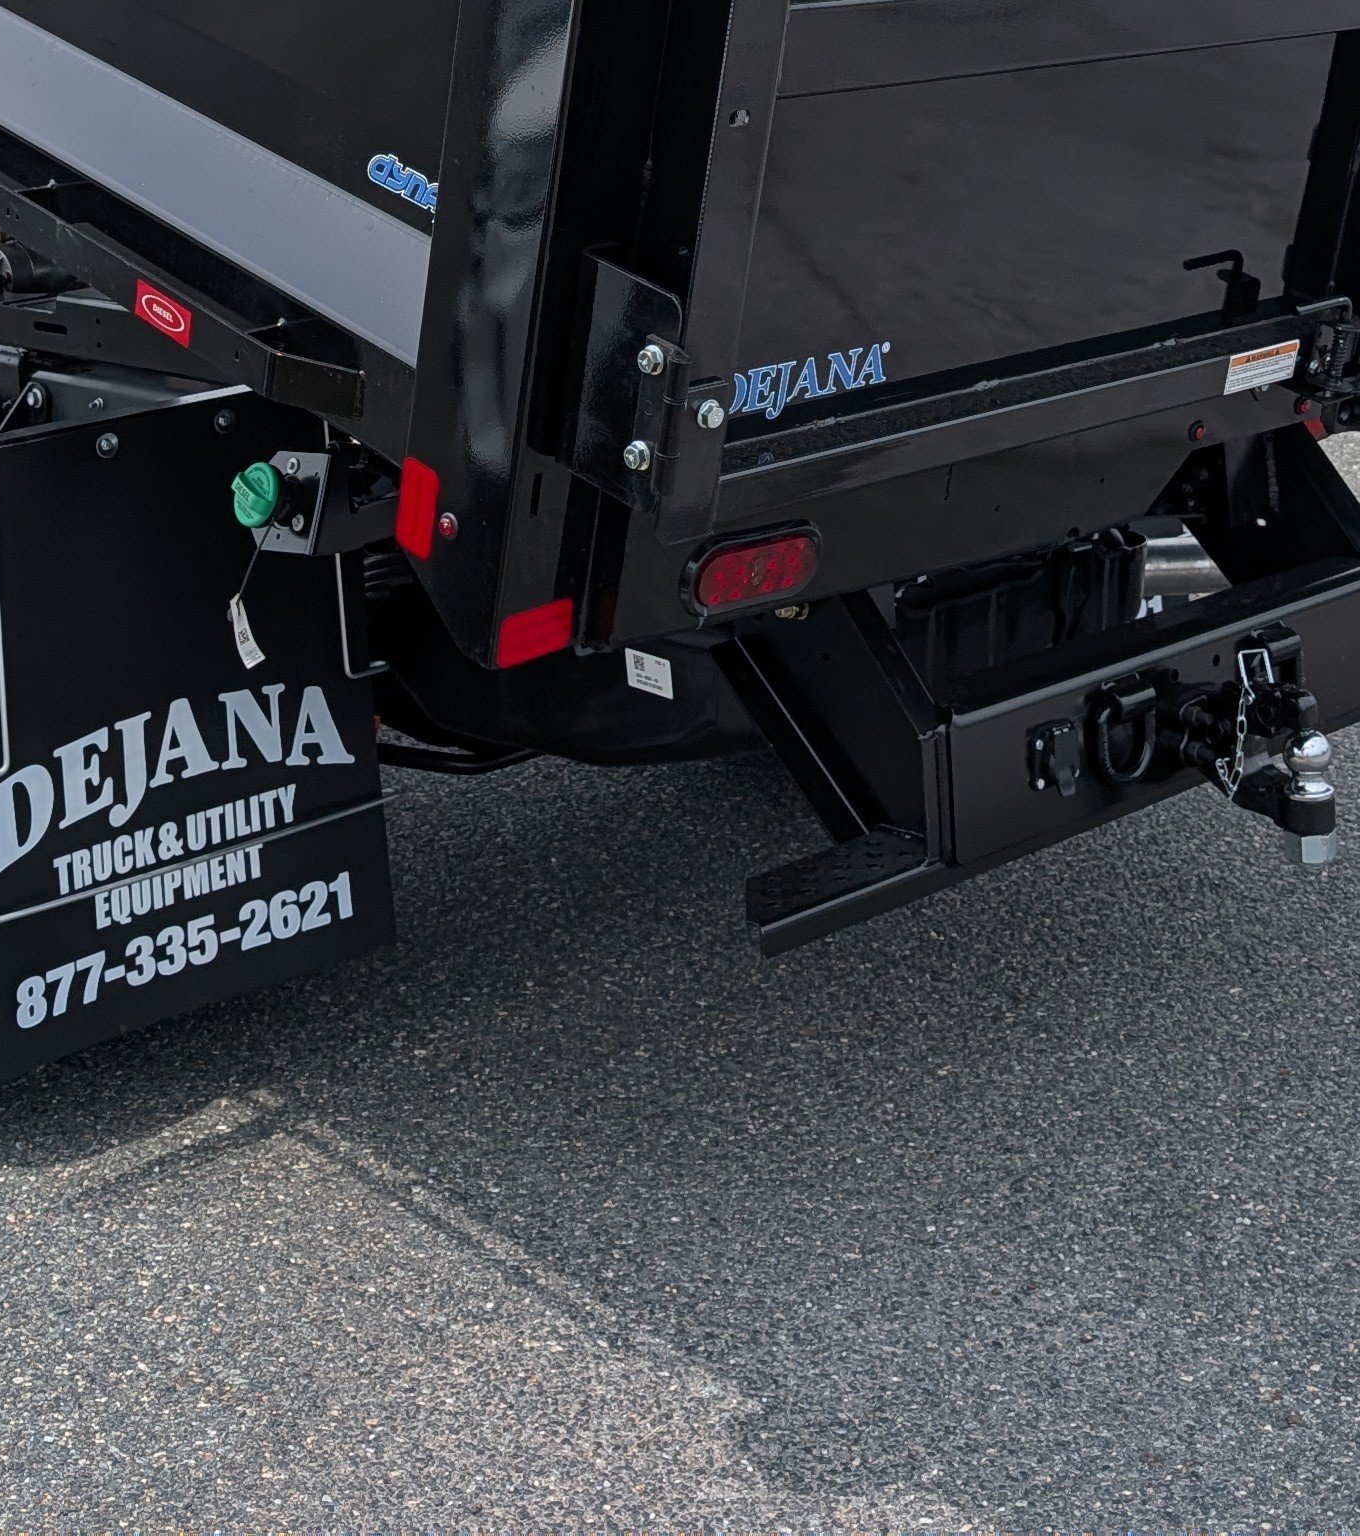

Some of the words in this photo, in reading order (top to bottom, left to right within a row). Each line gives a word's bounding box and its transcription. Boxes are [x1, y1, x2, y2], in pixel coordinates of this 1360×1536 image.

[152, 303, 174, 323] DIESEL
[53, 827, 156, 896] TRUCK
[185, 783, 297, 852] UTILITY
[94, 843, 264, 930] EQUIPMENT
[16, 871, 354, 1029] 877-335-2621
